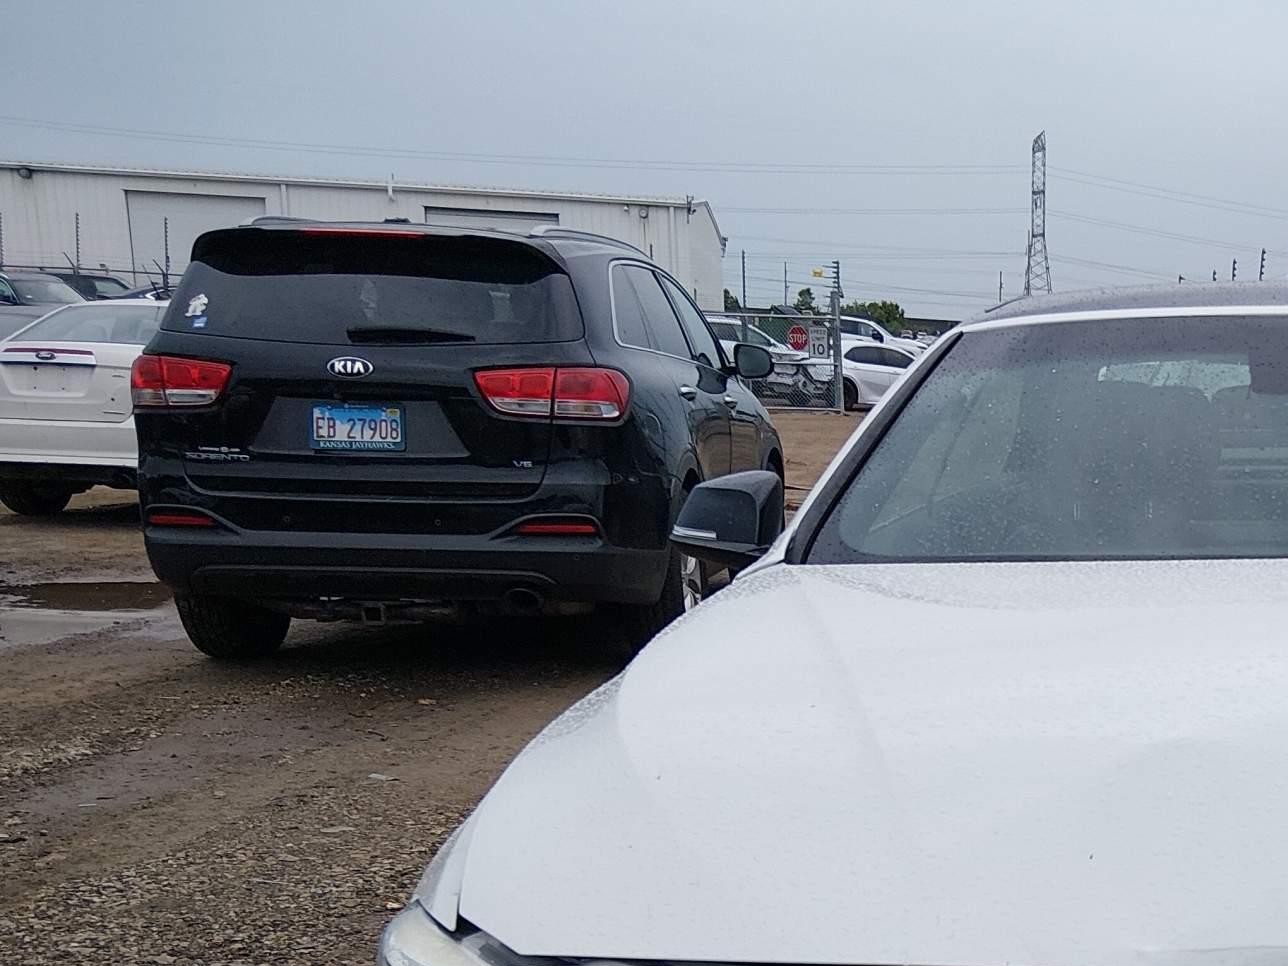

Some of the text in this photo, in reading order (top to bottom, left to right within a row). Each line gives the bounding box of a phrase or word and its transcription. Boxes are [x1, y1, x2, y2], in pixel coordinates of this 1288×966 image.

[789, 333, 806, 343] STOP
[812, 343, 825, 355] 10
[334, 360, 365, 374] KIA
[316, 416, 399, 440] EB 27908
[319, 440, 395, 449] KANSAS JAYHAWKS
[512, 460, 533, 468] V6
